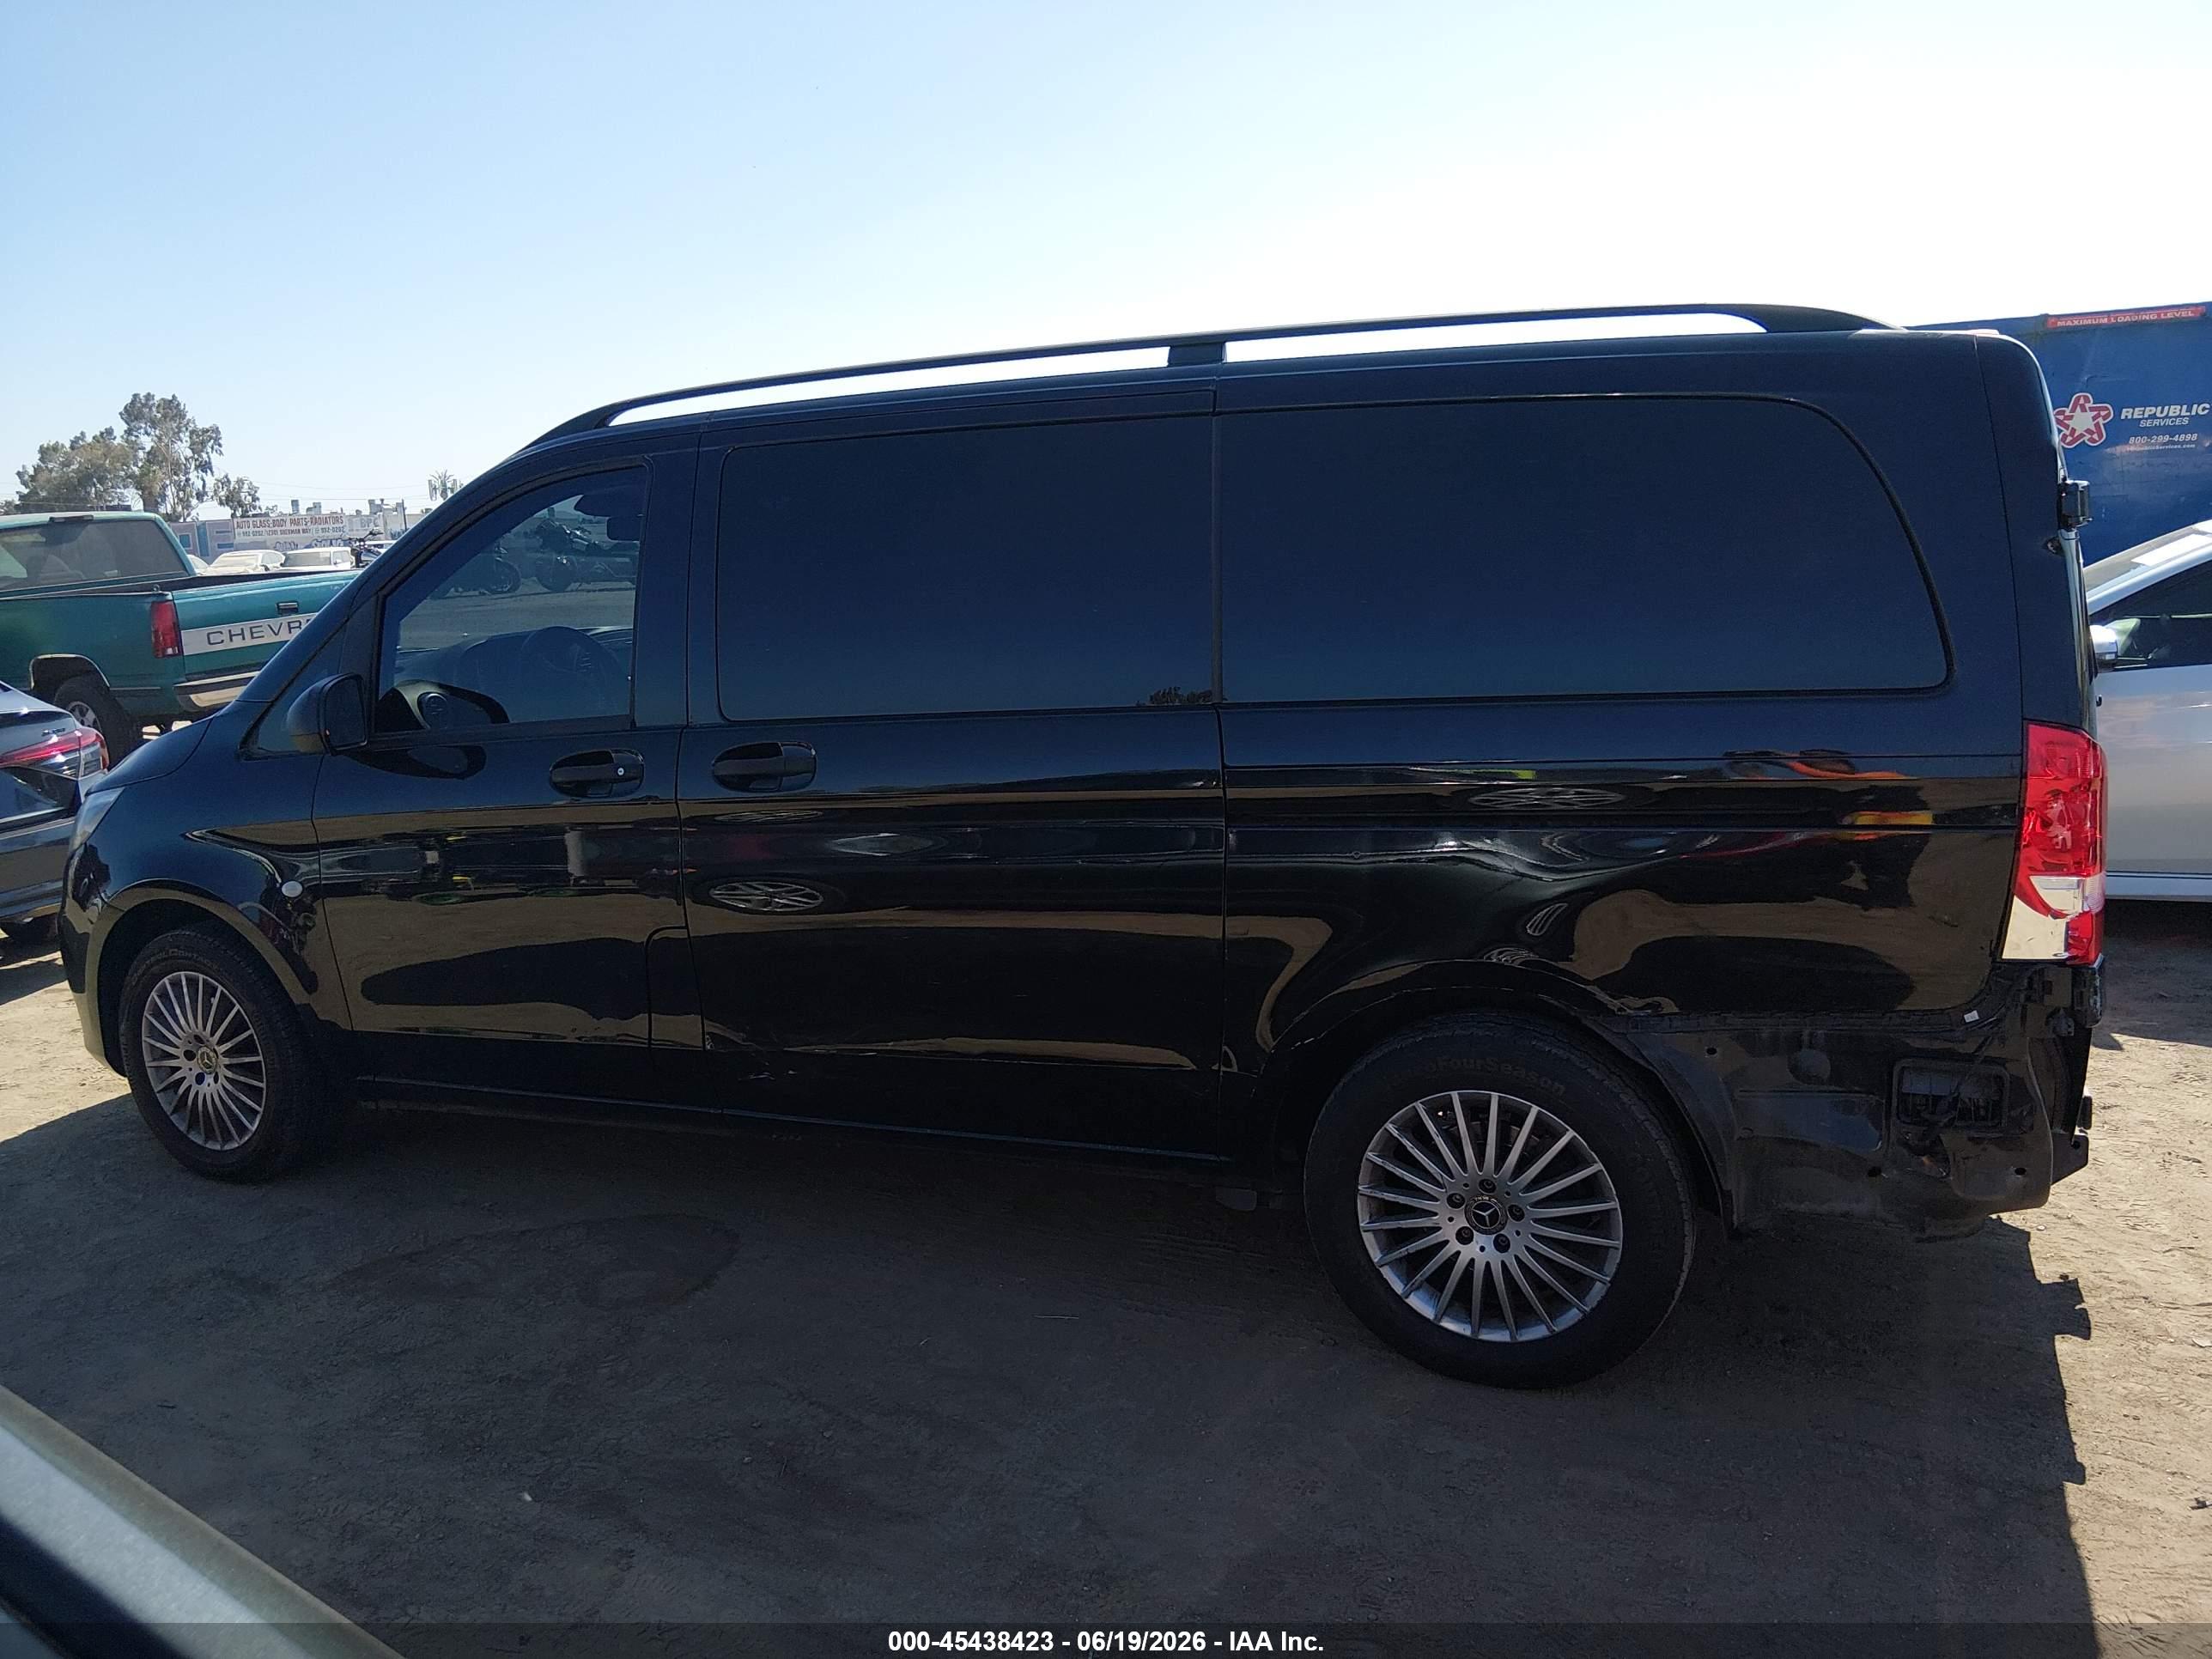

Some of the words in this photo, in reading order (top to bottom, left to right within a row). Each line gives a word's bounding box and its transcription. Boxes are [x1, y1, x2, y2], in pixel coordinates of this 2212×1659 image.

[2057, 318, 2107, 327] MAXIMUM
[2112, 314, 2158, 323] LOADING
[2161, 310, 2195, 319] LEVEL
[2120, 404, 2210, 419] REPUBLIC
[2139, 417, 2189, 428] SERVICES
[236, 520, 251, 529] AUTO
[206, 618, 312, 646] CHEVR
